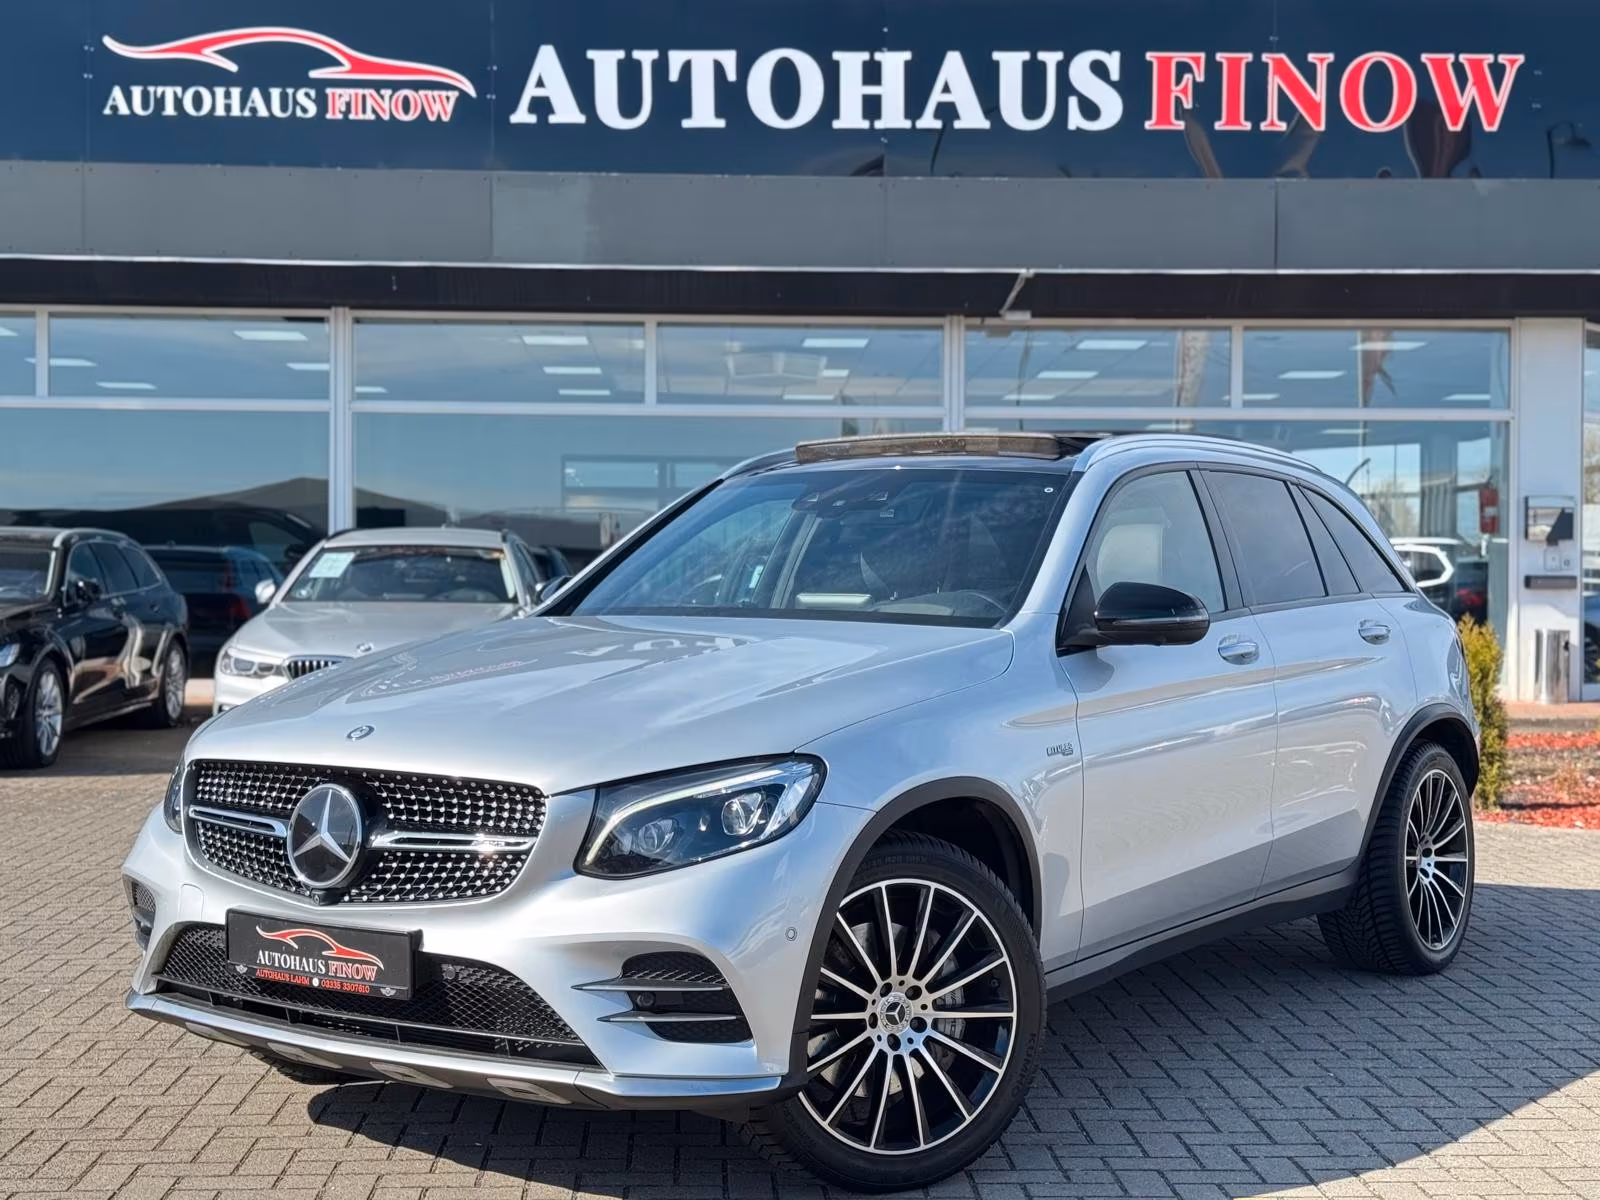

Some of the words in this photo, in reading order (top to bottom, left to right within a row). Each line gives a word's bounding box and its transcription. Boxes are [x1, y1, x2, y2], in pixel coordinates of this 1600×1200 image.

[103, 85, 316, 118] AUTOHAUS
[325, 88, 460, 122] FINOW
[509, 44, 1123, 131] AUTOHAUS
[1145, 51, 1525, 133] FINOW
[255, 969, 290, 982] AUTOHAUS
[290, 974, 310, 985] LAHM
[321, 979, 341, 990] 03335
[256, 950, 326, 975] AUTOHAUS
[328, 960, 378, 981] FINOW
